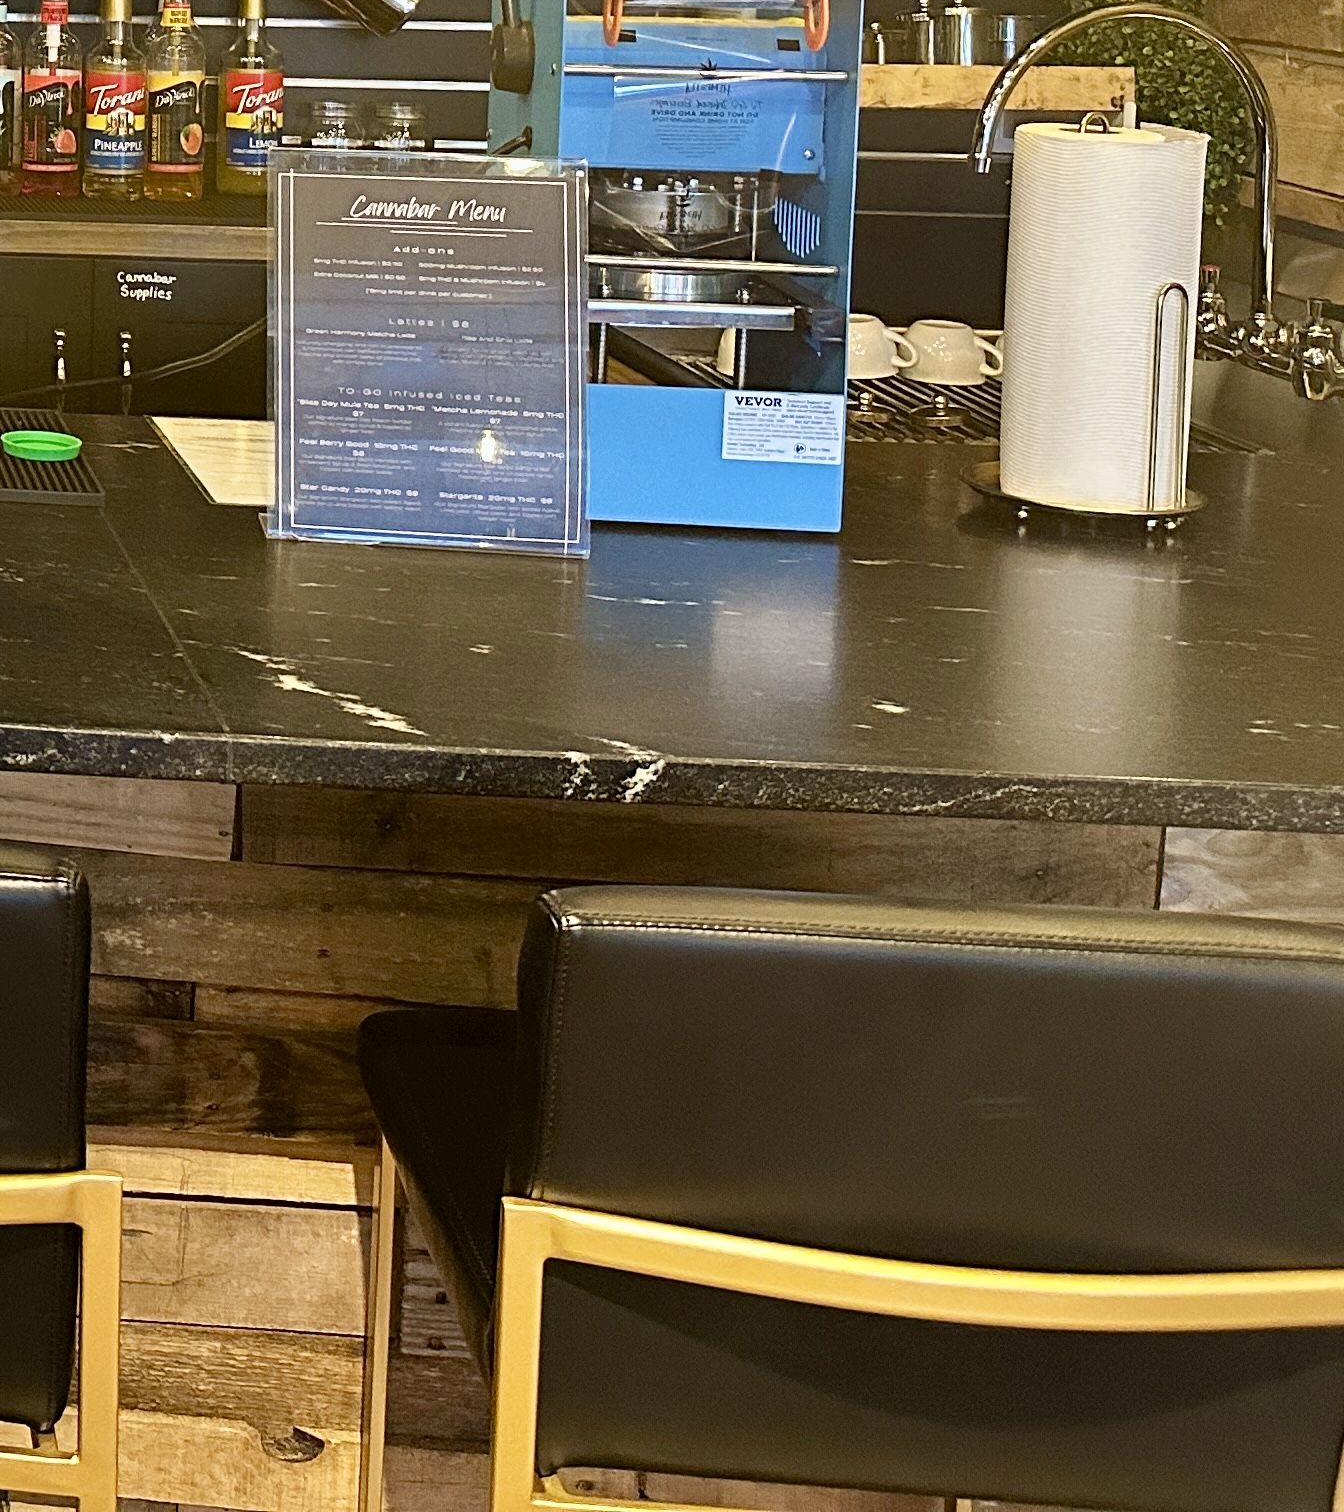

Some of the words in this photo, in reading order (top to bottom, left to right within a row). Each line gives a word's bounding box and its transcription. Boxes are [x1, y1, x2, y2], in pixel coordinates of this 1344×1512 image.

[349, 195, 441, 218] Cannabar
[448, 199, 506, 222] Menu
[120, 284, 172, 301] Supplies
[735, 396, 782, 407] VEVOR
